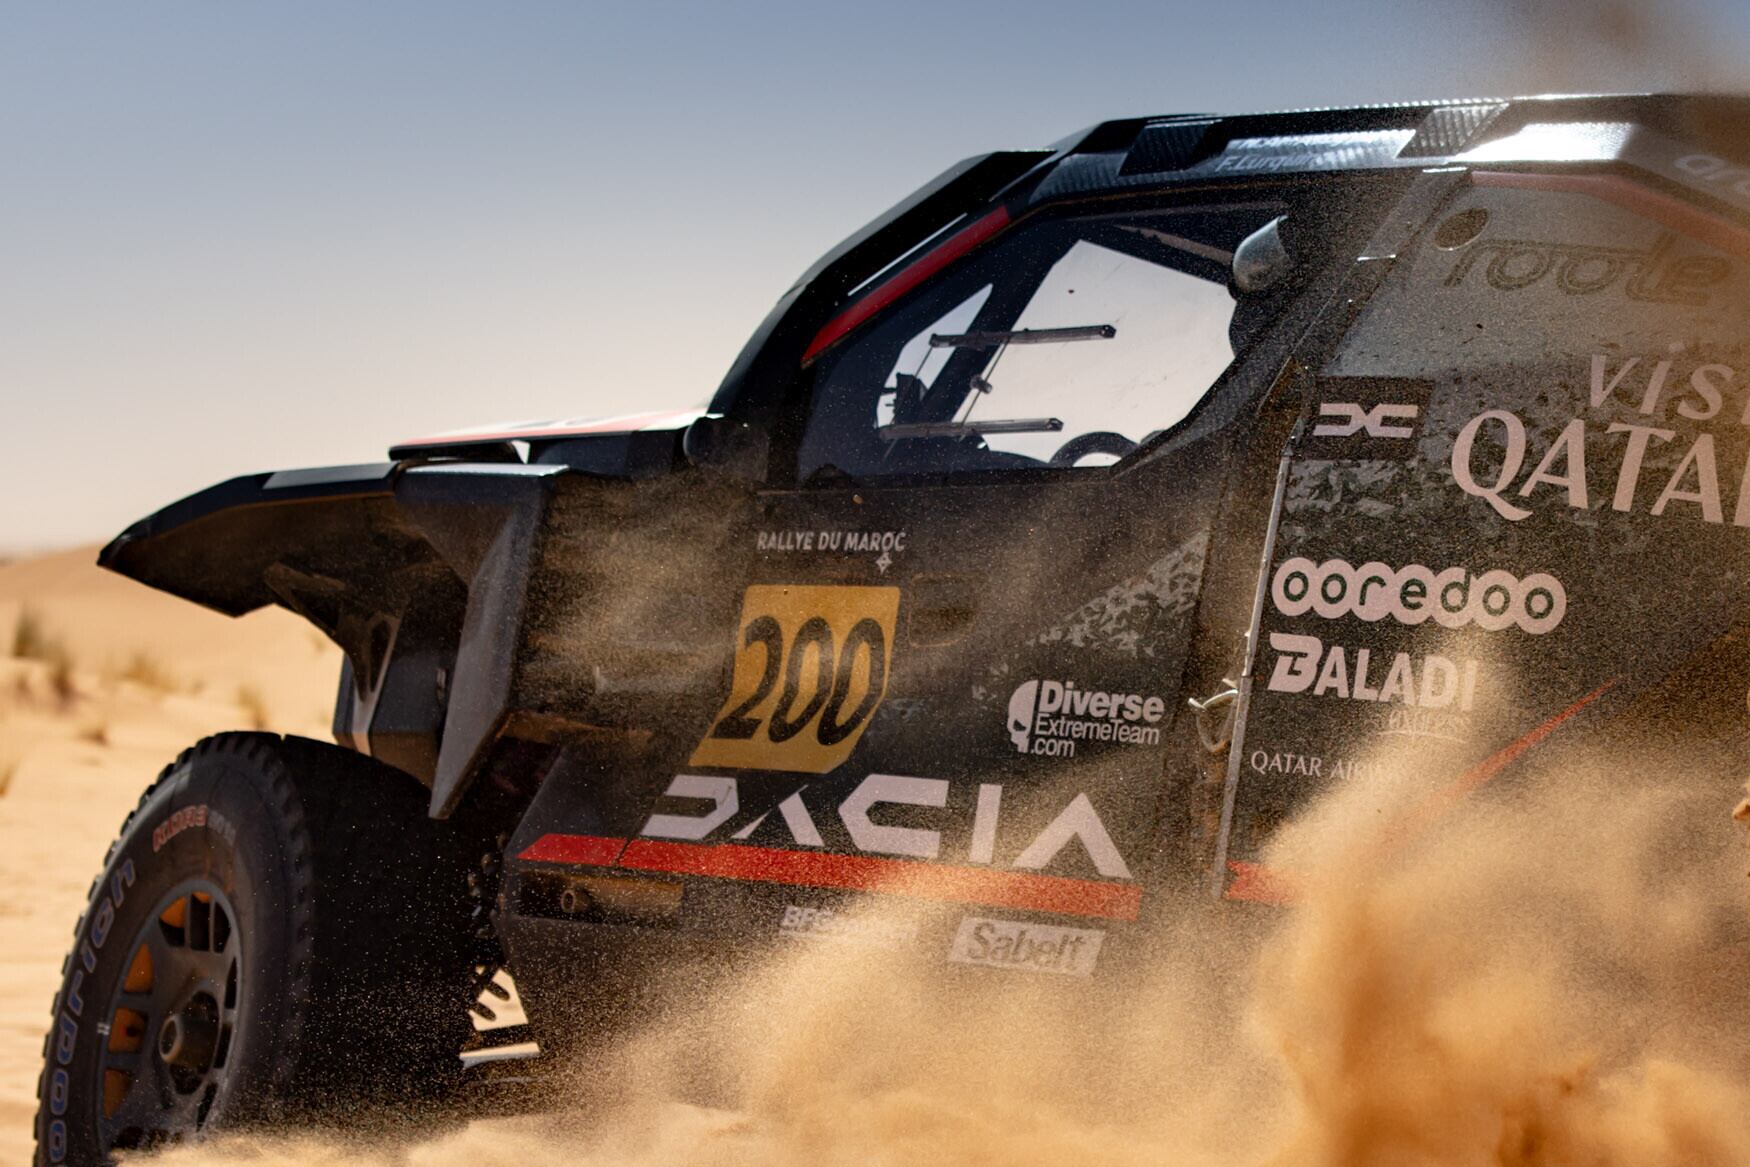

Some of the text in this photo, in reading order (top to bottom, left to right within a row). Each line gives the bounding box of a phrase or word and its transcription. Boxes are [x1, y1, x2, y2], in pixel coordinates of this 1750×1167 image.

[757, 531, 906, 552] RALLYE DU MAROC
[1277, 562, 1562, 628] ooredoo
[710, 616, 886, 746] 200
[1269, 632, 1478, 712] BALADI
[1038, 680, 1165, 724] Diverse
[1030, 736, 1075, 758] .com
[1035, 714, 1160, 746] ExtremeTeam
[1250, 750, 1323, 777] QATAR
[638, 774, 1134, 879] DACIA
[967, 921, 1086, 967] Sabelt
